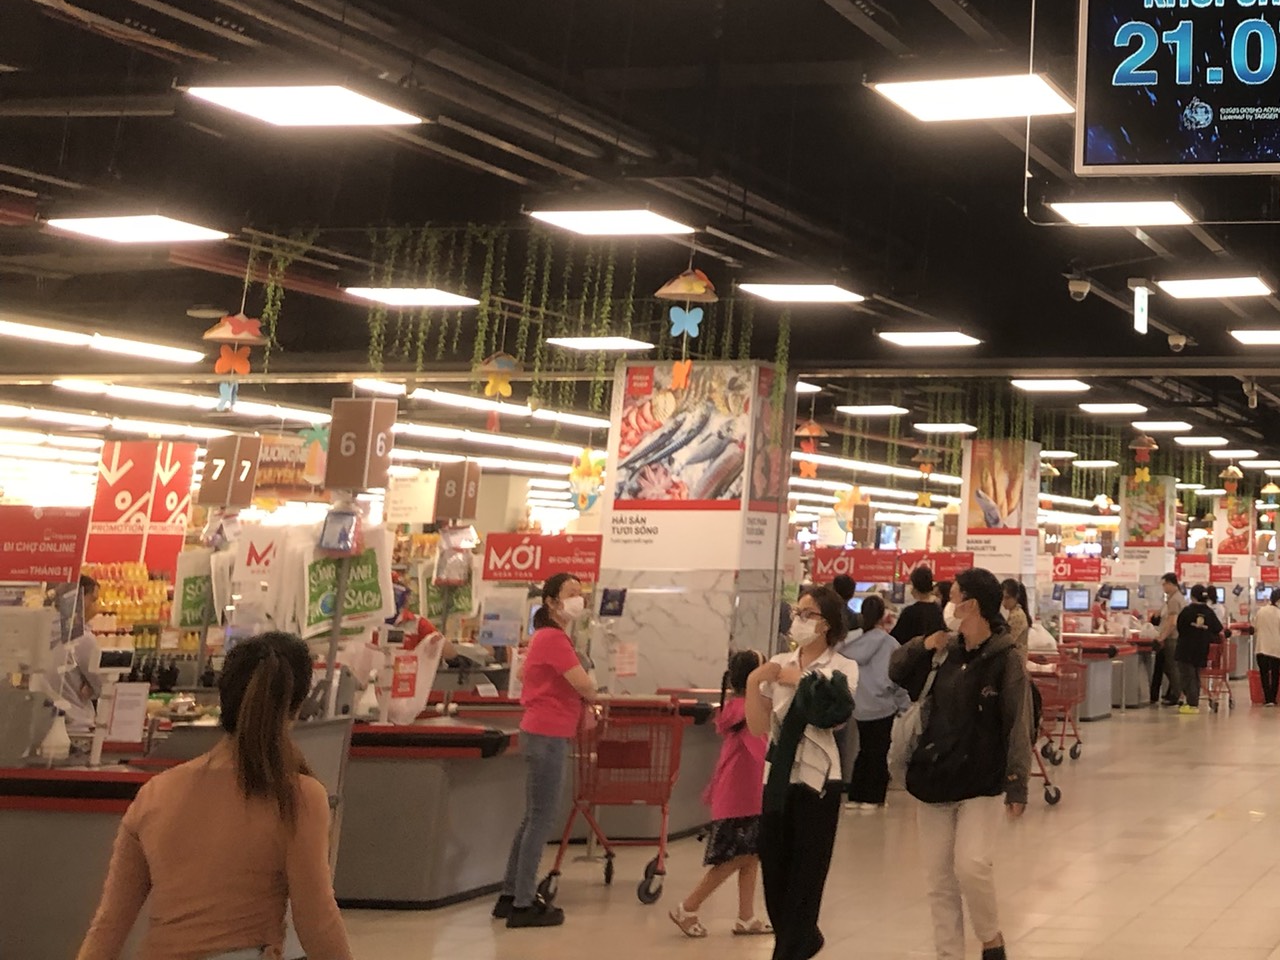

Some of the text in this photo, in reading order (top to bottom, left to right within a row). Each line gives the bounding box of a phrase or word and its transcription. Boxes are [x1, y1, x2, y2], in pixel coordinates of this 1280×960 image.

[340, 432, 356, 457] 6
[376, 432, 386, 457] 6
[211, 459, 226, 481] 7
[239, 460, 252, 482] 7
[445, 479, 457, 497] 8
[468, 480, 476, 498] 8
[39, 542, 76, 553] ONLINE
